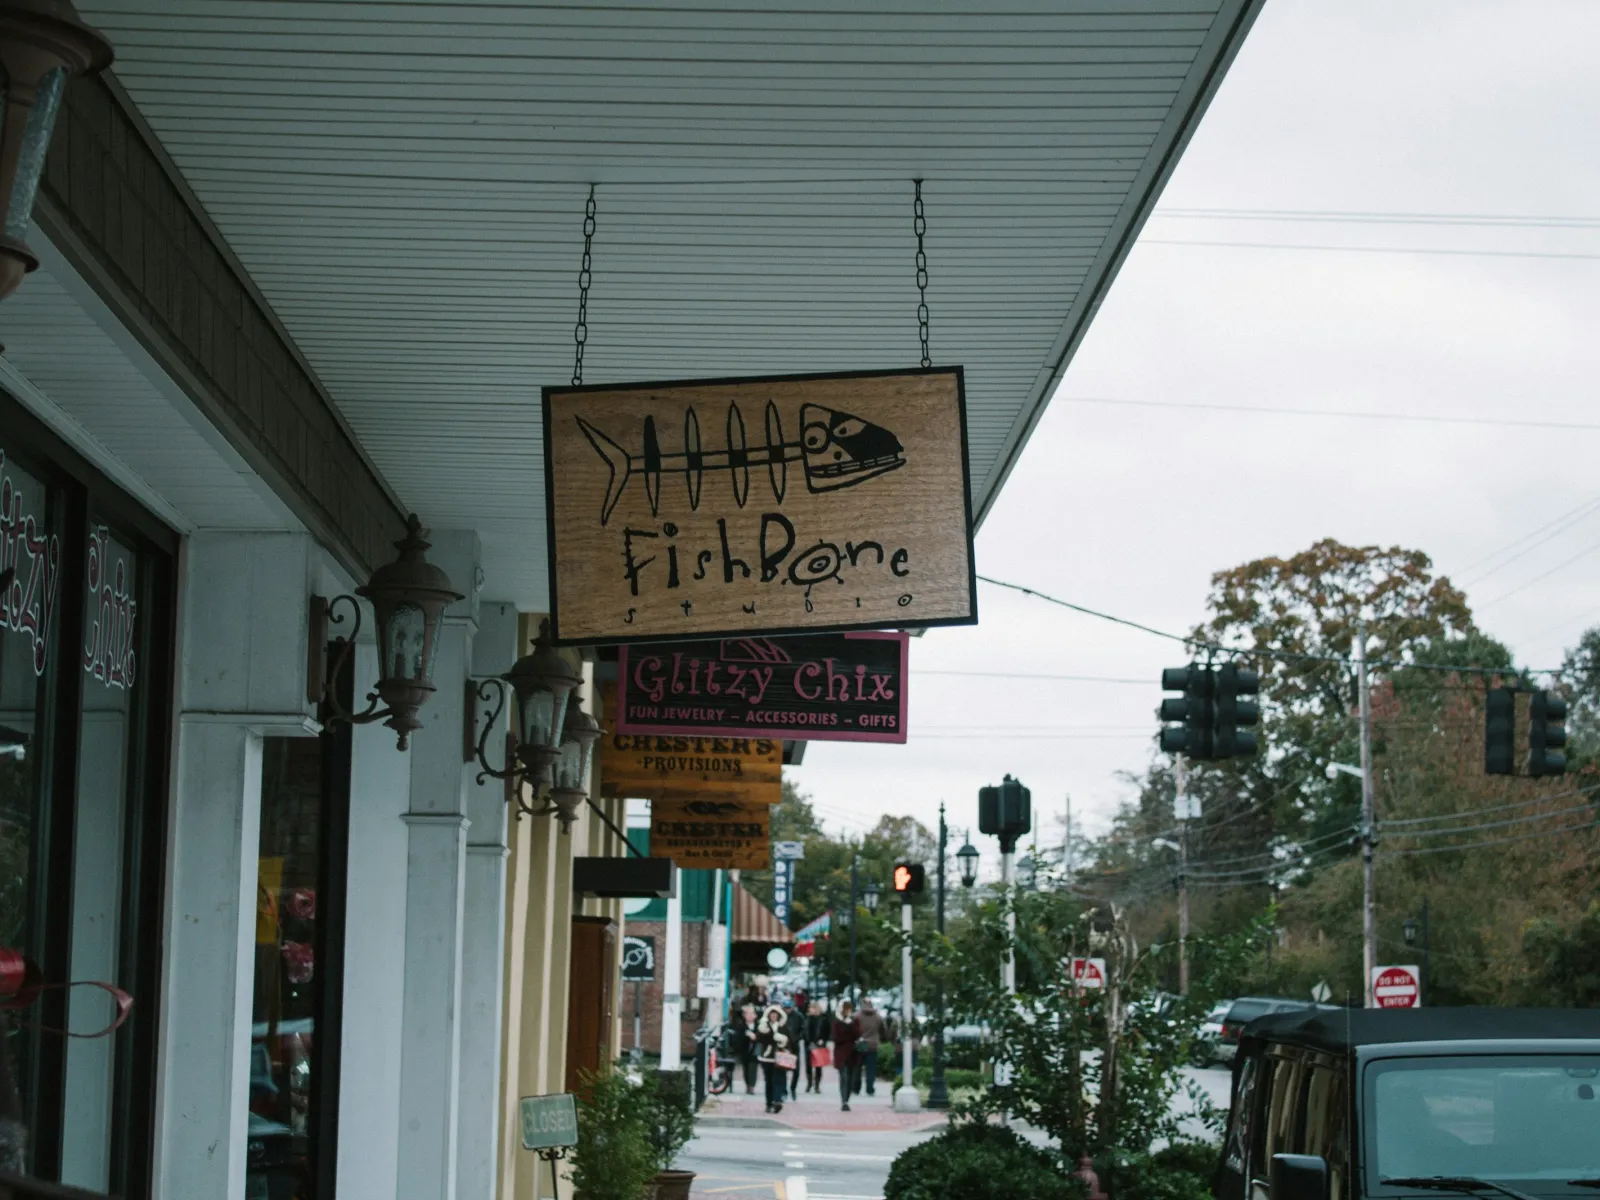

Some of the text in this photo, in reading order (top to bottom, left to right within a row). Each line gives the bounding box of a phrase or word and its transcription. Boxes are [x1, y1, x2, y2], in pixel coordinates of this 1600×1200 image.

[634, 653, 895, 704] Glitzy Chix
[629, 706, 657, 719] FUN
[662, 708, 724, 721] JEWELRY
[745, 710, 838, 726] ACCESSORIES
[859, 714, 896, 728] GIFTS
[1379, 975, 1410, 985] DO NOT
